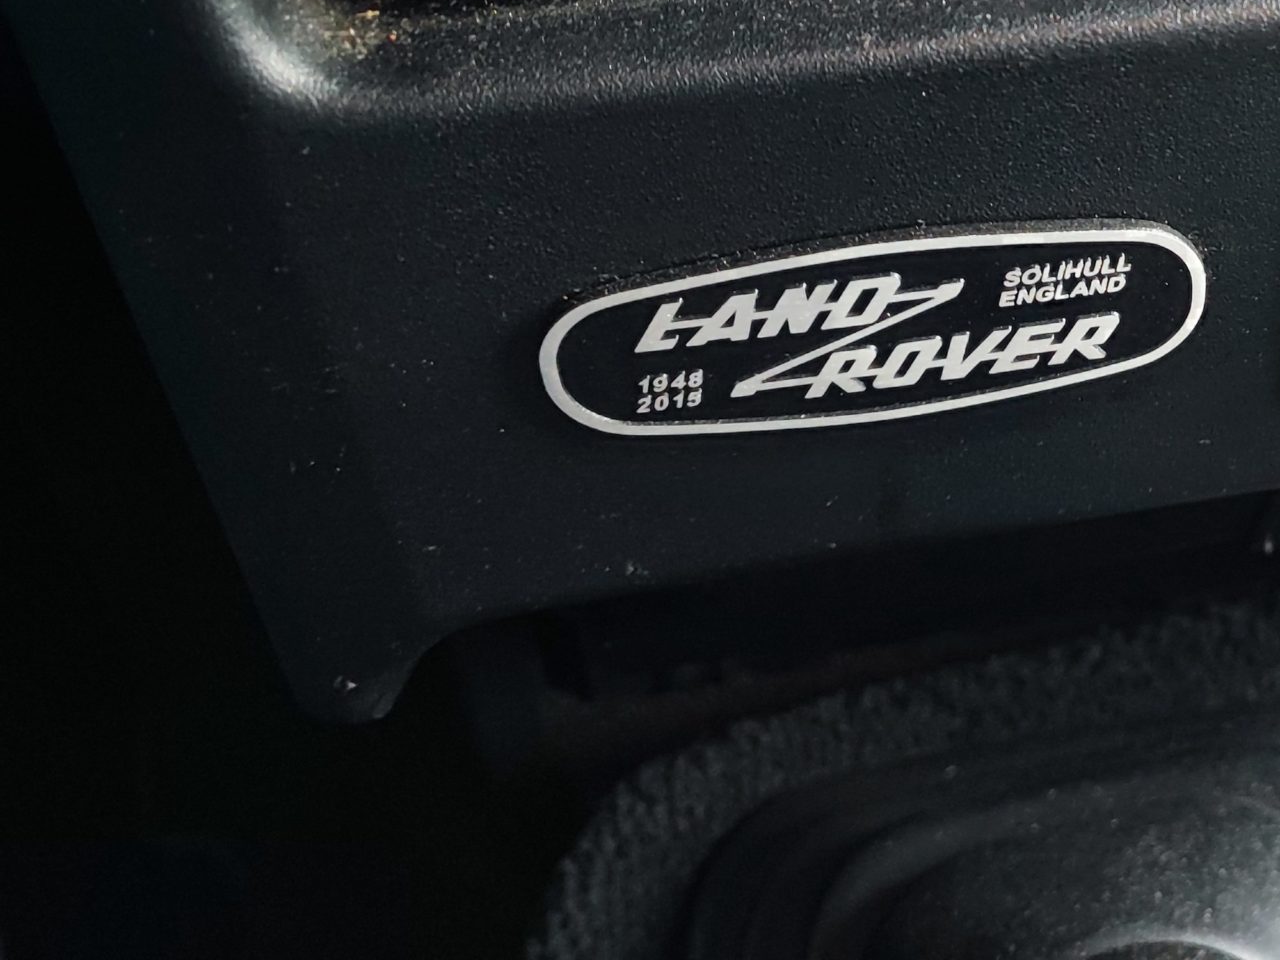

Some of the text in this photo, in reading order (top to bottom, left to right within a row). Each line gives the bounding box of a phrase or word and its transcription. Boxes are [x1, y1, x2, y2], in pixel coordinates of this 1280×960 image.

[1003, 252, 1132, 288] SOLIHULL
[998, 273, 1127, 308] ENGLAND
[633, 271, 905, 354] LAND
[804, 311, 1121, 400] ROVER
[638, 368, 704, 394] 1948
